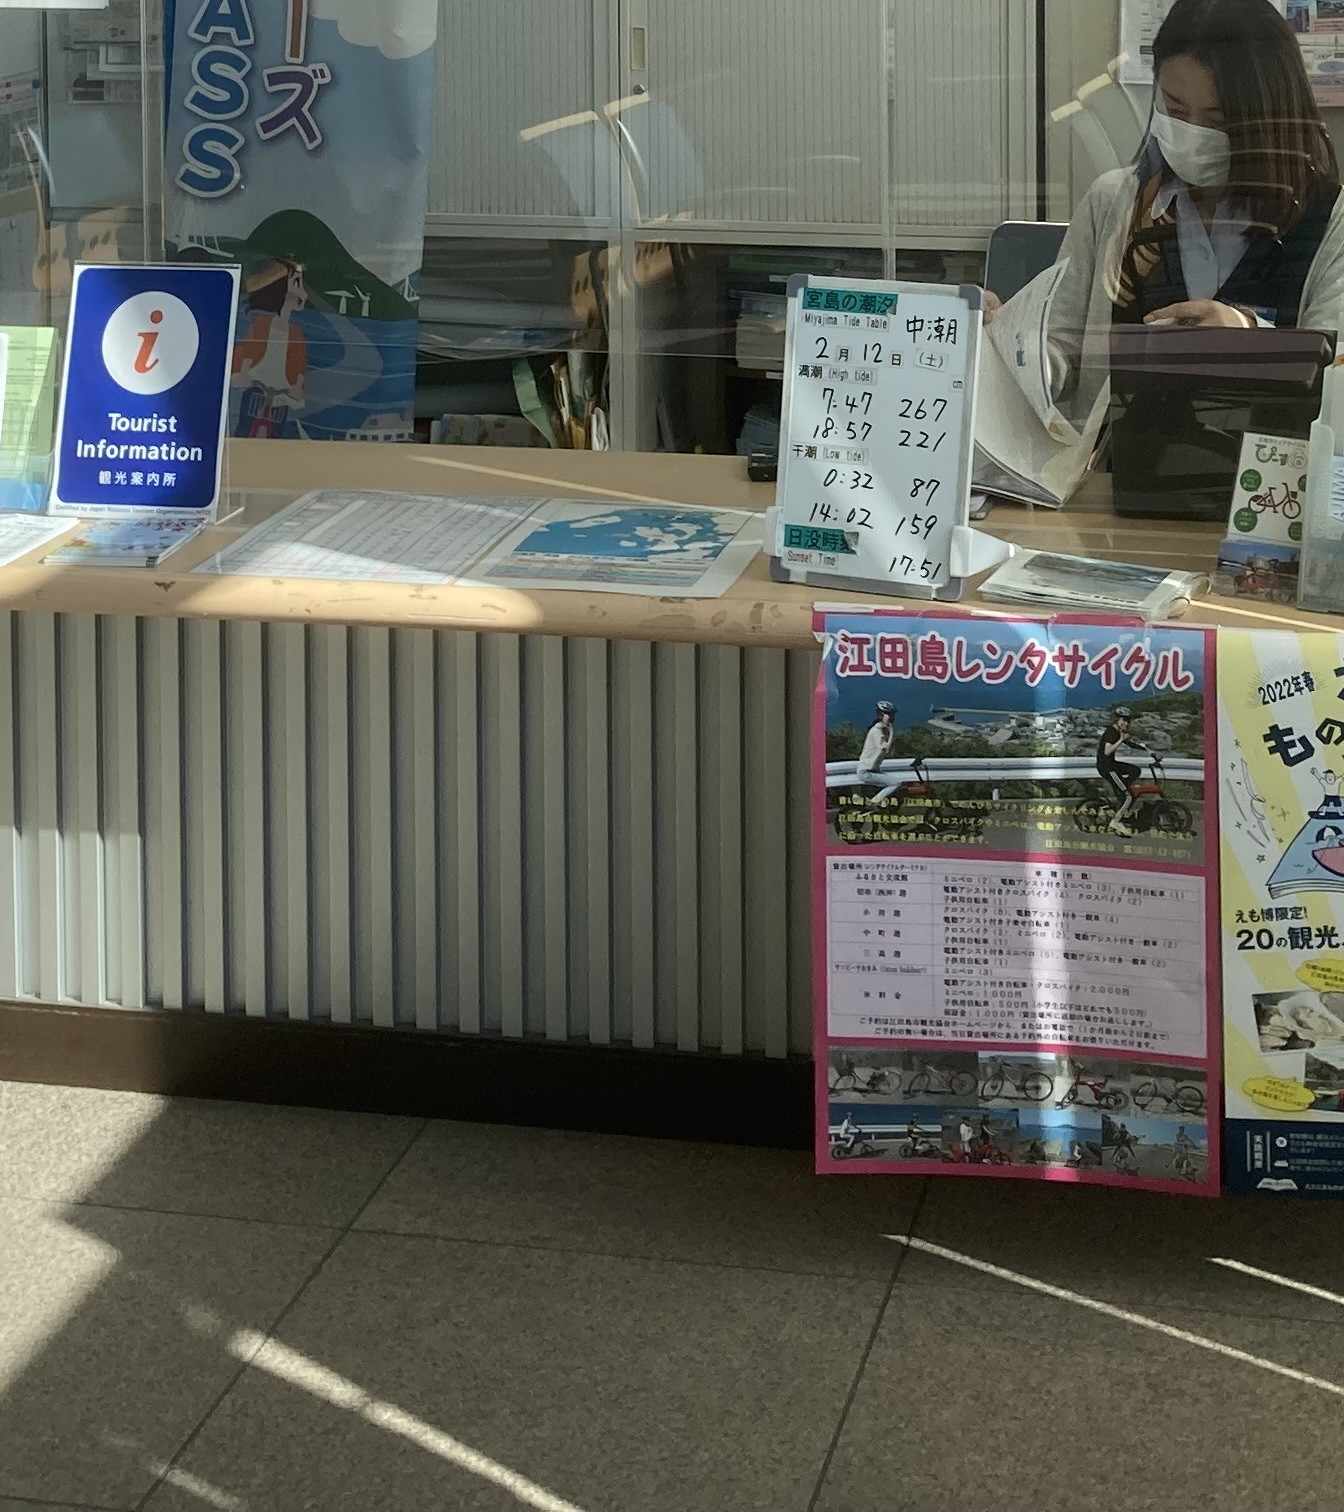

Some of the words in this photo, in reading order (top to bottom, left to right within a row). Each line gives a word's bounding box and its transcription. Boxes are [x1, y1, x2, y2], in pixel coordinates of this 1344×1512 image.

[804, 314, 838, 326] Miyajima
[843, 316, 861, 328] Tide
[866, 318, 888, 329] Table
[906, 315, 958, 345] 中潮
[898, 398, 948, 423] 267
[108, 412, 178, 434] Tourist
[76, 439, 203, 462] Information
[792, 444, 818, 460] 干潮
[98, 471, 177, 488] 観光案内所
[823, 468, 875, 491] 0:32
[909, 478, 941, 507] 87
[809, 502, 873, 530] 14:02
[895, 514, 938, 540] 159
[889, 557, 942, 580] 17:51
[836, 630, 1195, 692] 江田島レンタサイクル
[1258, 670, 1316, 706] 2022年春
